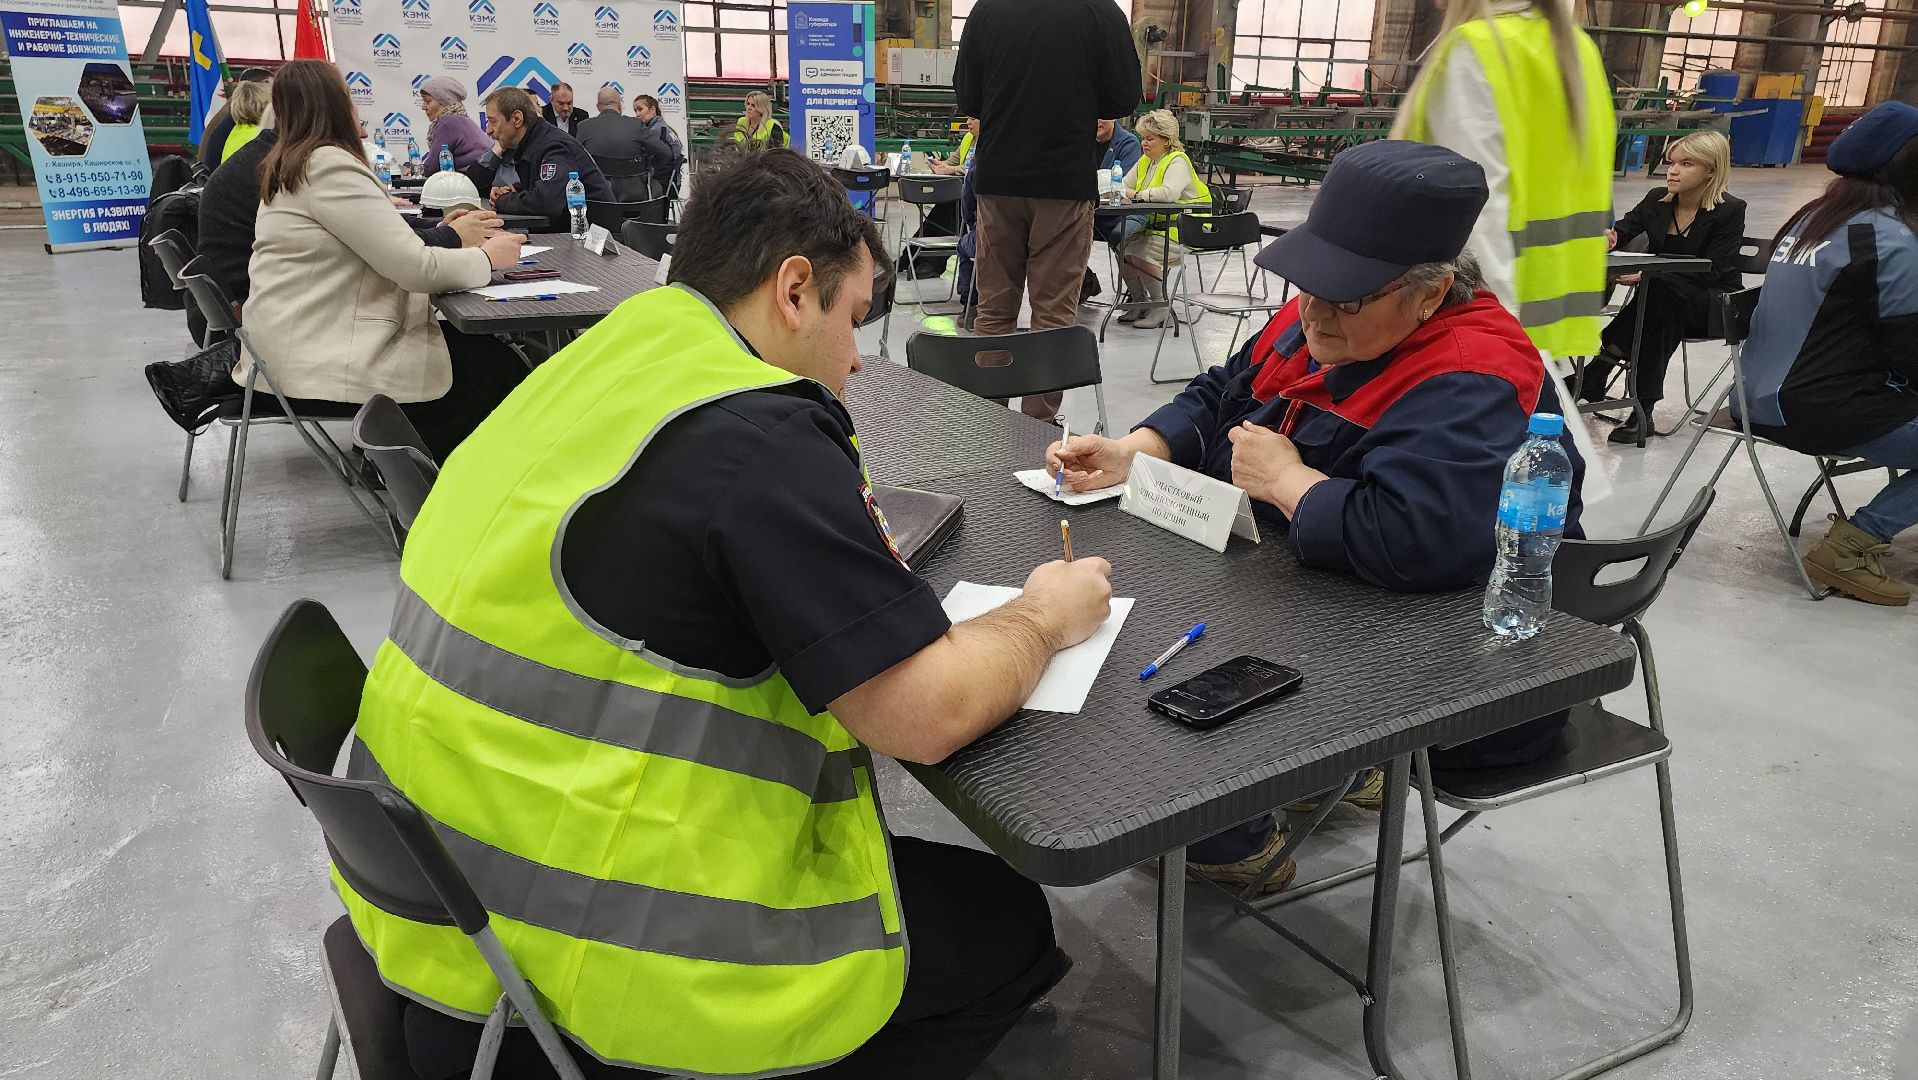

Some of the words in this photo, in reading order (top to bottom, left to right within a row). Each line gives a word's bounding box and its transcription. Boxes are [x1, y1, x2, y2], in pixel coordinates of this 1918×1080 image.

[28, 18, 86, 30] ПРИГЛАШАЕМ
[87, 21, 98, 30] НА
[8, 28, 120, 43] ИНЖЕНЕРНО-ТЕХНИЧЕСКИЕ
[18, 42, 24, 51] И
[26, 42, 66, 53] РАБОЧИЕ
[67, 44, 117, 56] ДОЛЖНОСТИ
[802, 88, 862, 96] ОБЪЕДИНЯЕМСЯ
[56, 171, 144, 184] 8-915-050-71-90
[58, 185, 146, 198] 8-496-695-13-90
[52, 208, 96, 221] ЭНЕРГИЯ
[98, 205, 146, 218] РАЗВИТИЯ
[83, 223, 91, 234] В
[93, 220, 131, 234] ЛЮДЯХ!
[1154, 480, 1204, 505] УЧАСТКОВЫЙ
[1151, 506, 1186, 527] ПОЛИЦИИ
